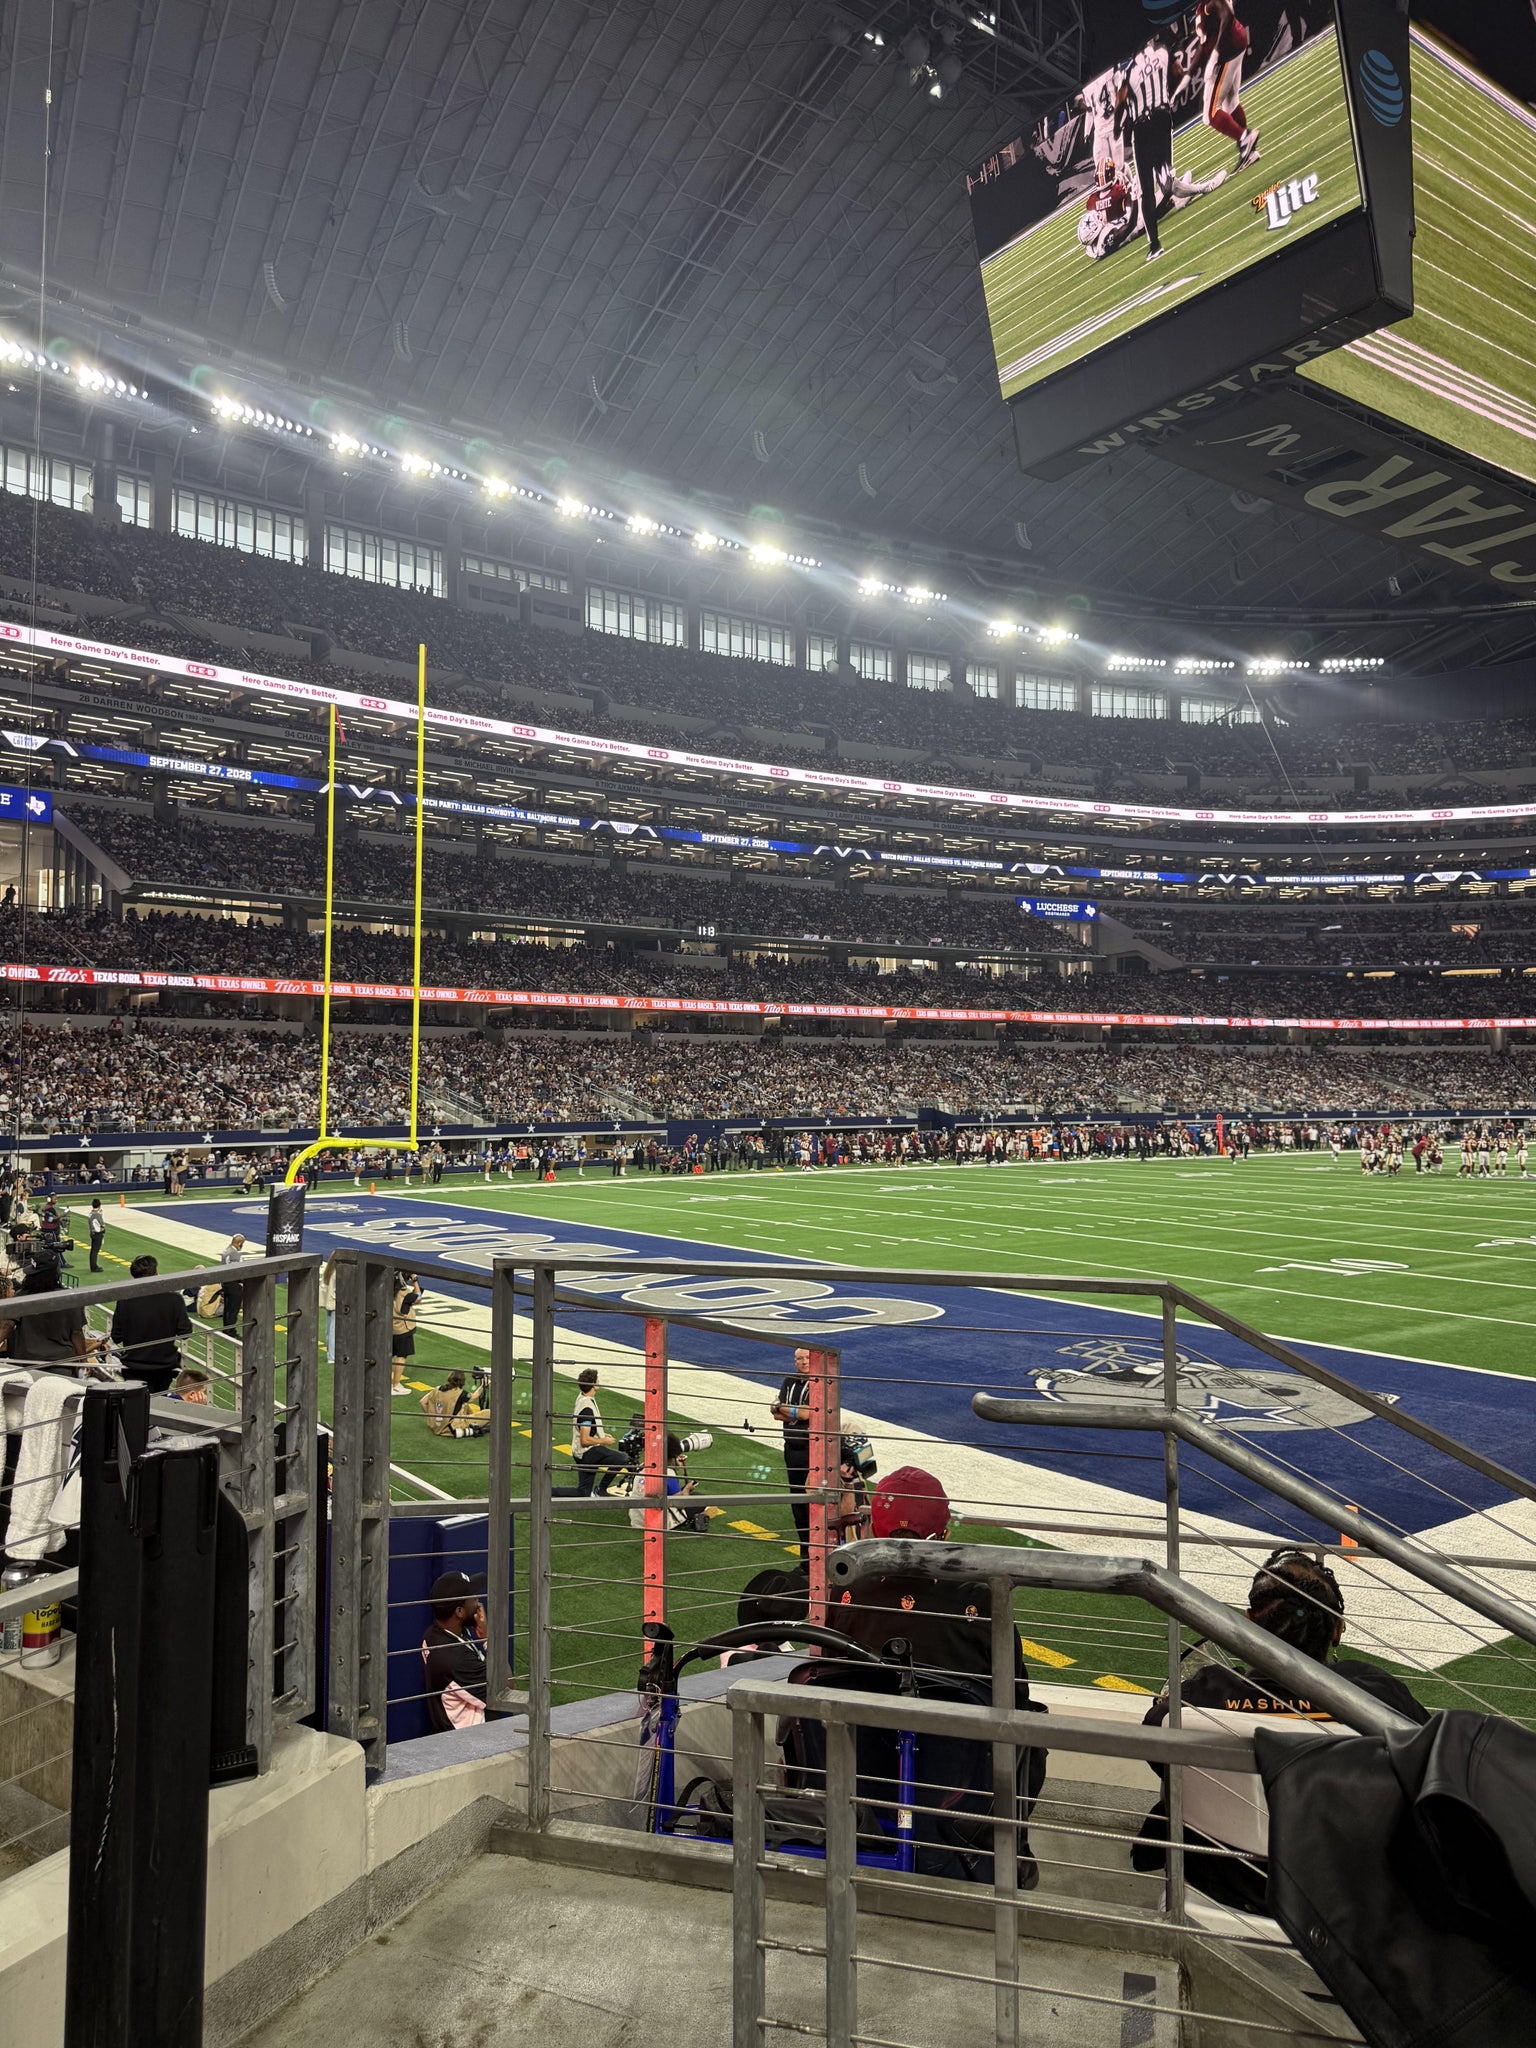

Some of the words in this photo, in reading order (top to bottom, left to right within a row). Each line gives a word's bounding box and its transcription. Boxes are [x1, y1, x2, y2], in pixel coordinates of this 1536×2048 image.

[1265, 173, 1318, 229] Lite
[1078, 339, 1333, 455] WINSTAR
[50, 638, 73, 647] Here
[75, 642, 102, 653] Game
[104, 648, 129, 659] Day's
[130, 653, 160, 664] Better.
[263, 680, 287, 688] Game
[288, 685, 310, 694] Day's
[311, 689, 337, 698] Better.
[80, 694, 90, 702] 28
[94, 696, 133, 710] DARREN
[136, 704, 184, 720] WOODSON
[409, 708, 427, 717] Hee
[427, 712, 449, 720] Game
[449, 715, 469, 724] Day's
[470, 719, 492, 728] Better.
[297, 732, 332, 745] CHARLE
[150, 757, 206, 773] SEPTEMBER
[209, 766, 224, 776] 27,
[226, 768, 252, 780] 2026
[464, 761, 494, 772] MICHAEL
[416, 798, 438, 806] ATCH
[439, 799, 461, 810] PARTY:
[462, 804, 486, 813] DALLAS
[486, 808, 515, 818] COWBOYS
[702, 832, 740, 845] SEPTEMBER
[740, 836, 751, 846] 27,
[1036, 902, 1080, 912] LUCCHESE
[8, 966, 40, 979] OWNED.
[48, 968, 88, 983] Tito's
[93, 971, 118, 982] TEXAS
[119, 972, 142, 984] BORN.
[143, 974, 166, 986] TEXAS
[168, 976, 196, 987] RAISED.
[197, 978, 216, 988] STILL
[218, 978, 240, 989] TEXAS
[241, 980, 268, 990] OWNED.
[274, 981, 307, 993] Tito's
[312, 984, 332, 993] TEXS
[334, 984, 353, 994] BORN.
[354, 986, 374, 995] TEXAS
[375, 986, 398, 996] RAISED.
[436, 990, 458, 999] OWNED.
